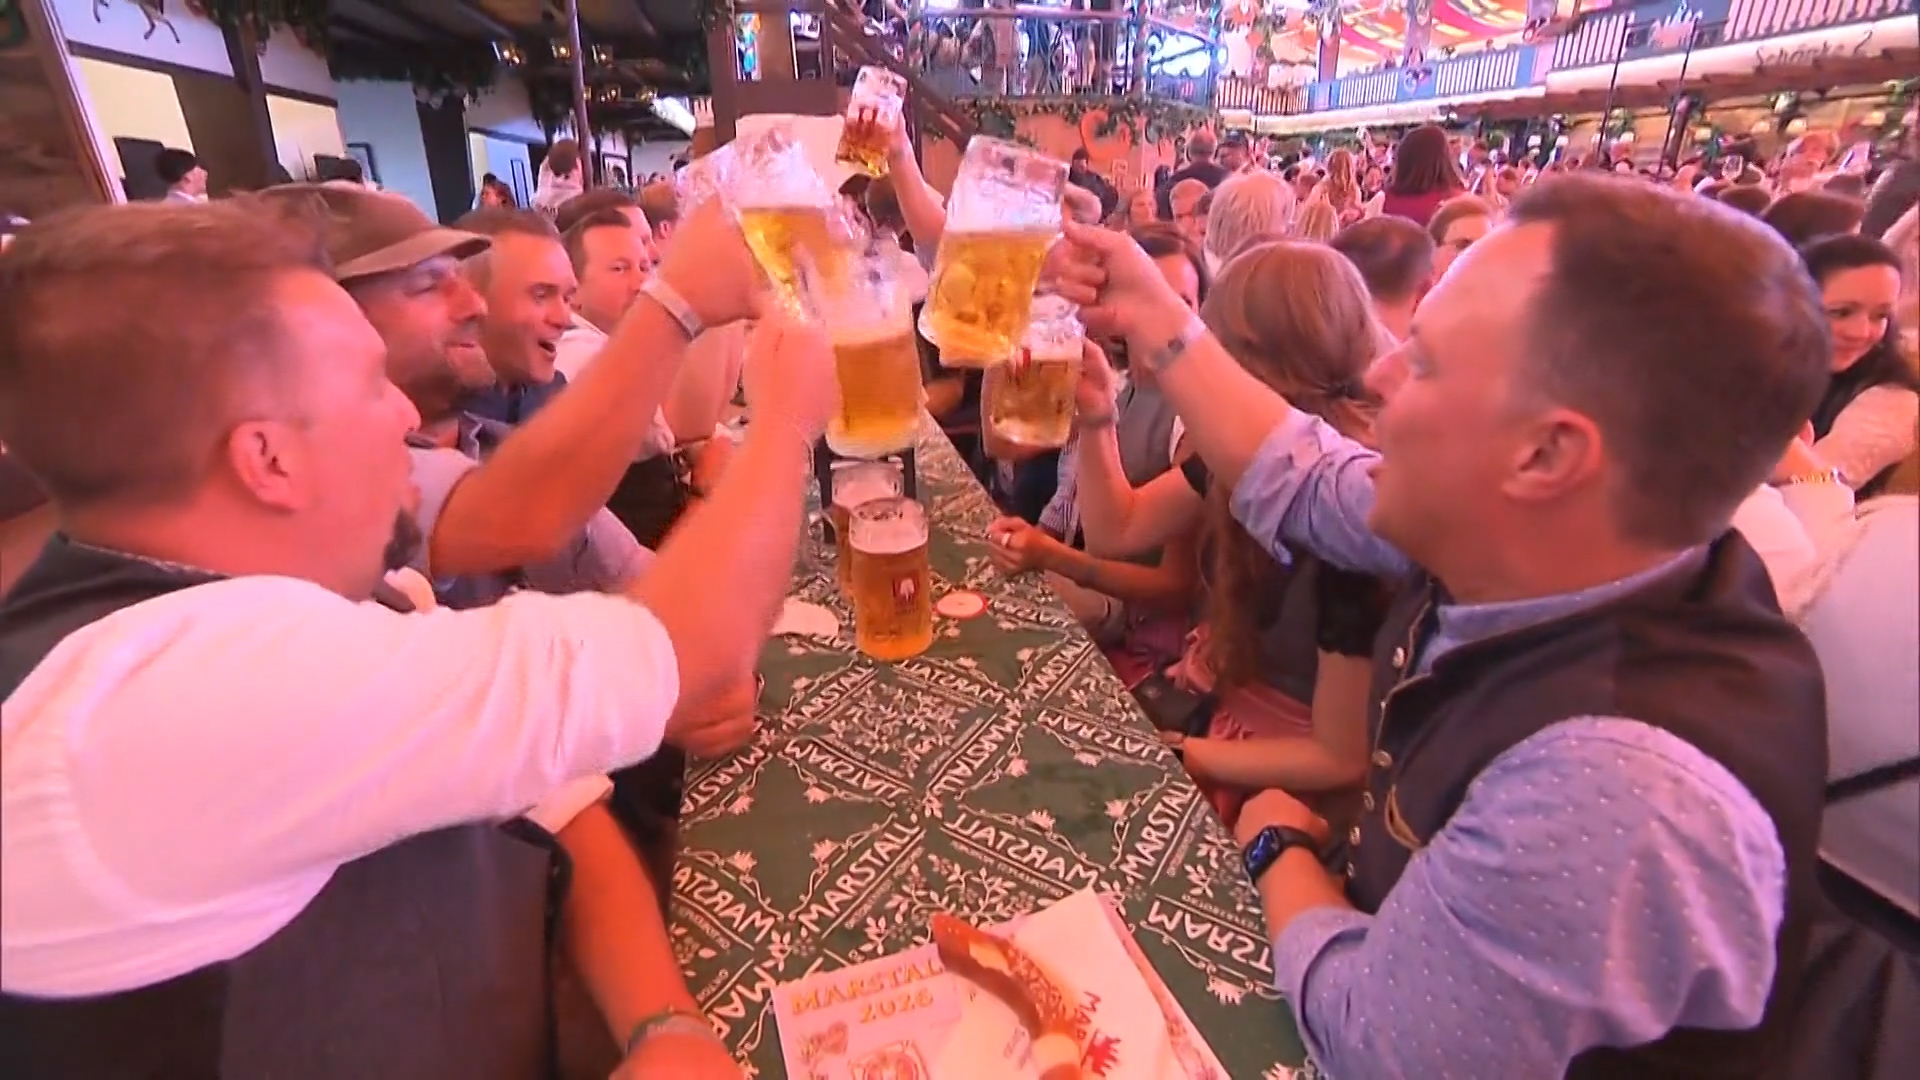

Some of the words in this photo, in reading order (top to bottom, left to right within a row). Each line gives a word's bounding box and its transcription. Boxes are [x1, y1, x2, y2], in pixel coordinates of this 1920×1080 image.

[680, 745, 765, 814] MARSTA
[1119, 781, 1197, 881] MARSTALL
[799, 822, 921, 932] MARSTALL
[791, 958, 944, 1017] MARSTAL
